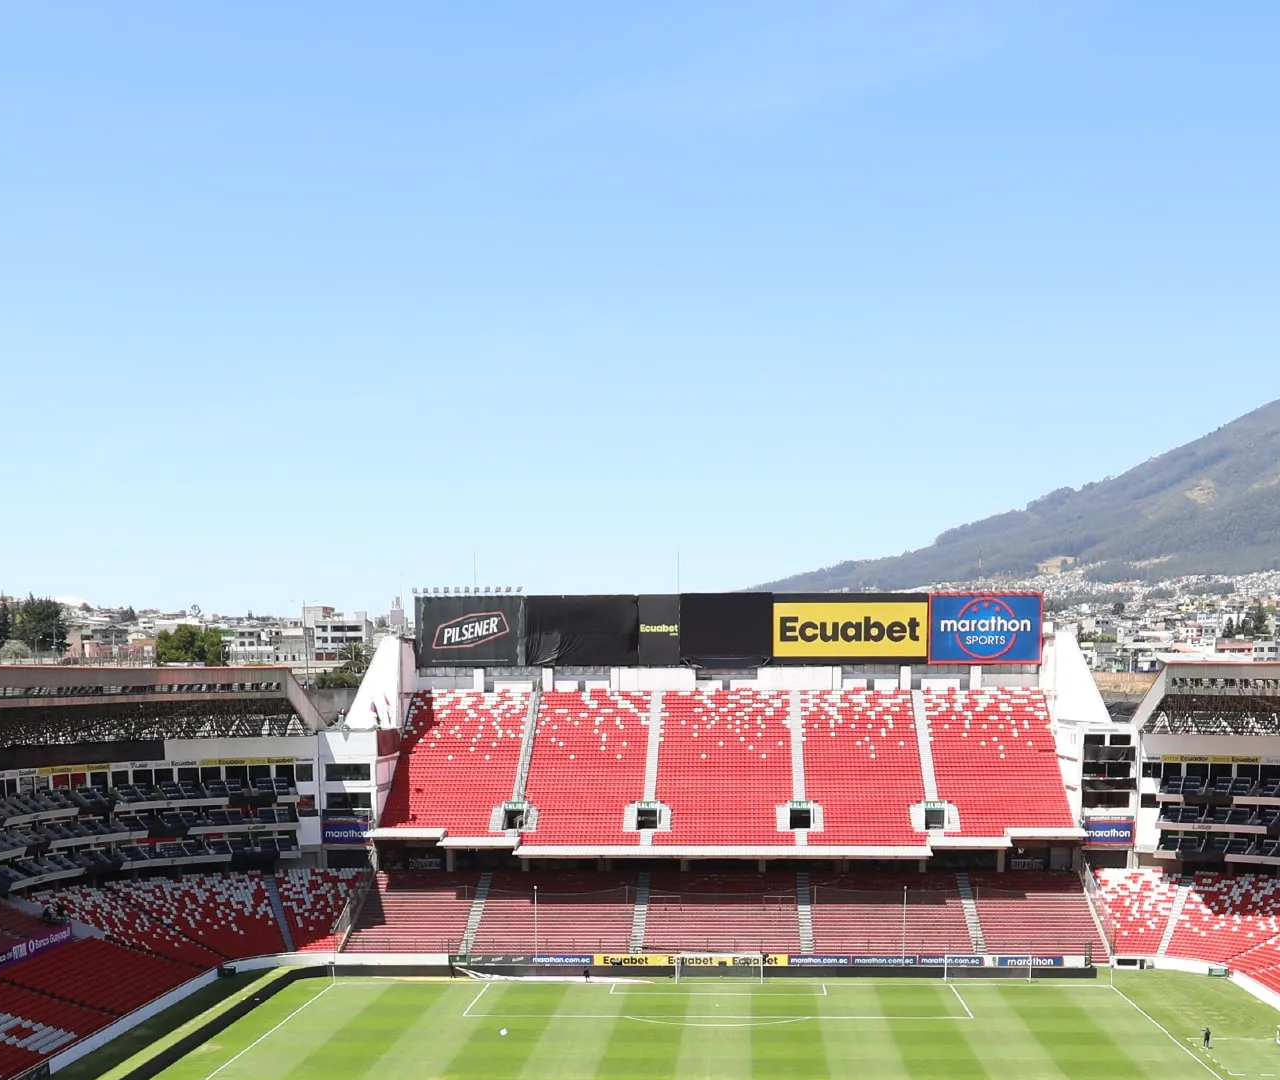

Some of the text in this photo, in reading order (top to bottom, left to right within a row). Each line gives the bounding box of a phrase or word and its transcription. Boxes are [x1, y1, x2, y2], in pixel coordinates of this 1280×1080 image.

[640, 624, 678, 633] Ecuabet
[779, 616, 920, 643] Ecuabet
[940, 617, 1031, 633] marathon
[443, 616, 499, 644] PILSENER
[965, 635, 1006, 646] SPORTS
[532, 956, 591, 964] marathon.com.ec
[790, 957, 848, 965] marathon.com.ec
[854, 957, 914, 965] marathon.com.ec
[1007, 957, 1054, 966] marathon
